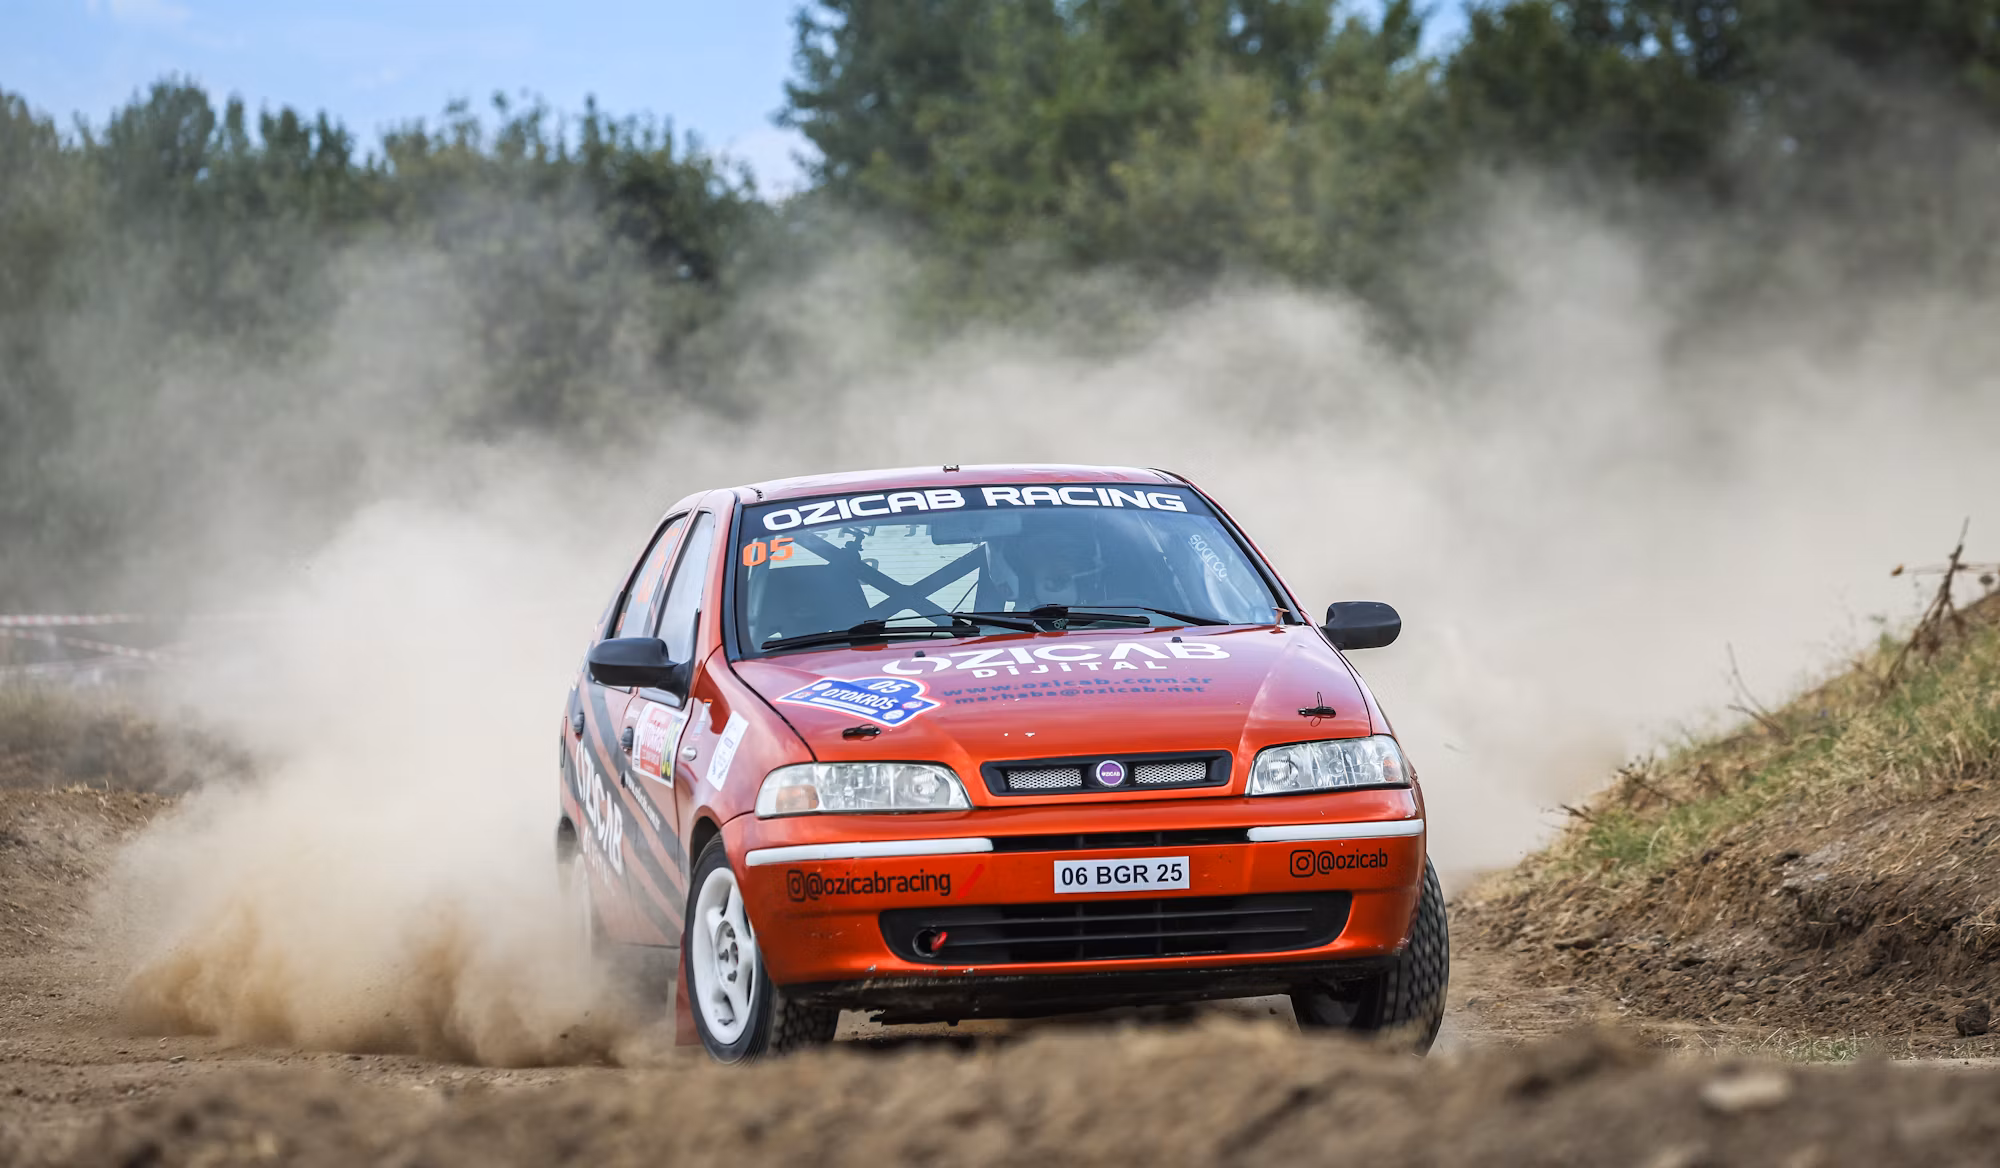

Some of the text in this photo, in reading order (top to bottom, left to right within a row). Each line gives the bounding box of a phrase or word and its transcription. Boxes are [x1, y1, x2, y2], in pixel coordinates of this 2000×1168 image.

[762, 486, 1188, 531] OZICAB RACING
[742, 537, 795, 566] 05
[821, 688, 899, 710] OTOKROS
[868, 680, 911, 693] 05
[944, 677, 1212, 697] www.ozicab.com.tr
[1317, 848, 1388, 875] @ozicab
[805, 869, 951, 901] @ozicabracing
[1061, 863, 1183, 886] 06 BGR 25
